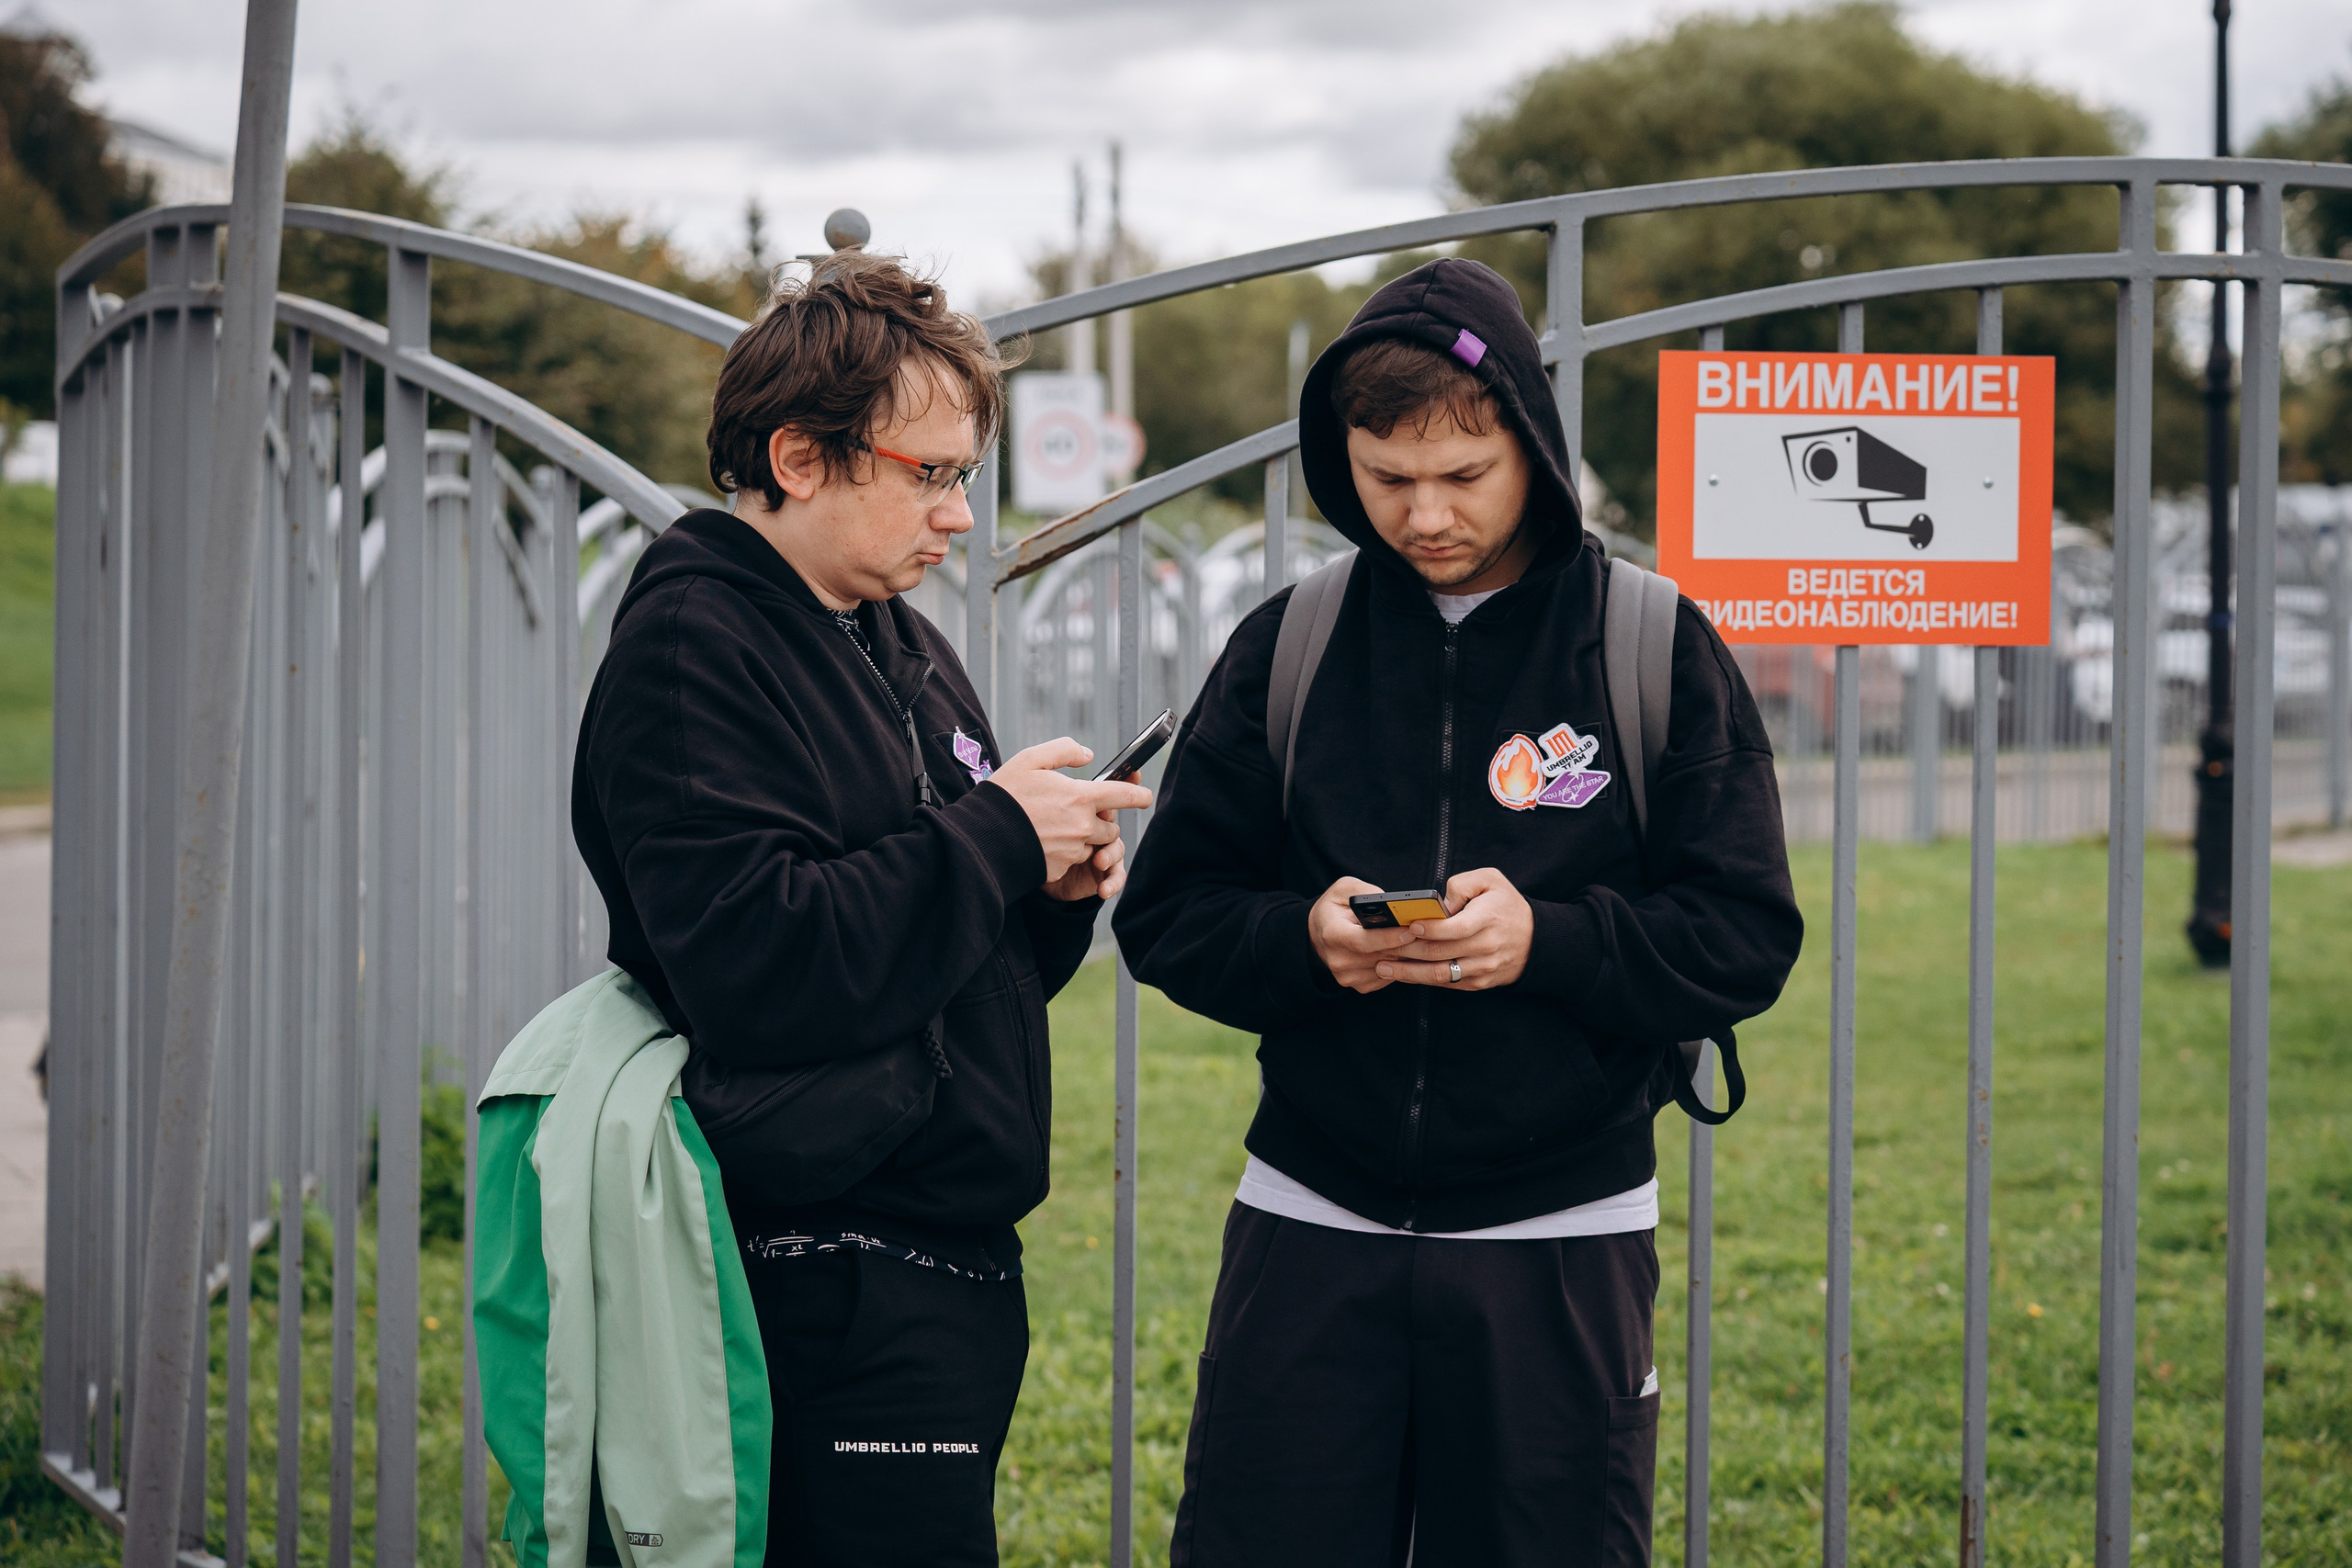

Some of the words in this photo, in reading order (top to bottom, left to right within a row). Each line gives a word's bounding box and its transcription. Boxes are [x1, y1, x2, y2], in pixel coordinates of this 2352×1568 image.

[1697, 360, 2019, 412] ВНИМАНИЕ!
[1787, 568, 1926, 599] ВЕДЕТСЯ
[1546, 740, 1593, 772] UMBRELLIO
[1543, 792, 1558, 801] YOU
[1558, 786, 1572, 796] ARE
[1572, 782, 1586, 791] THE
[1586, 775, 1605, 787] STAR
[834, 1441, 926, 1453] UMBRELLIO
[933, 1443, 979, 1453] PEOPLE
[628, 1533, 645, 1544] DRY
